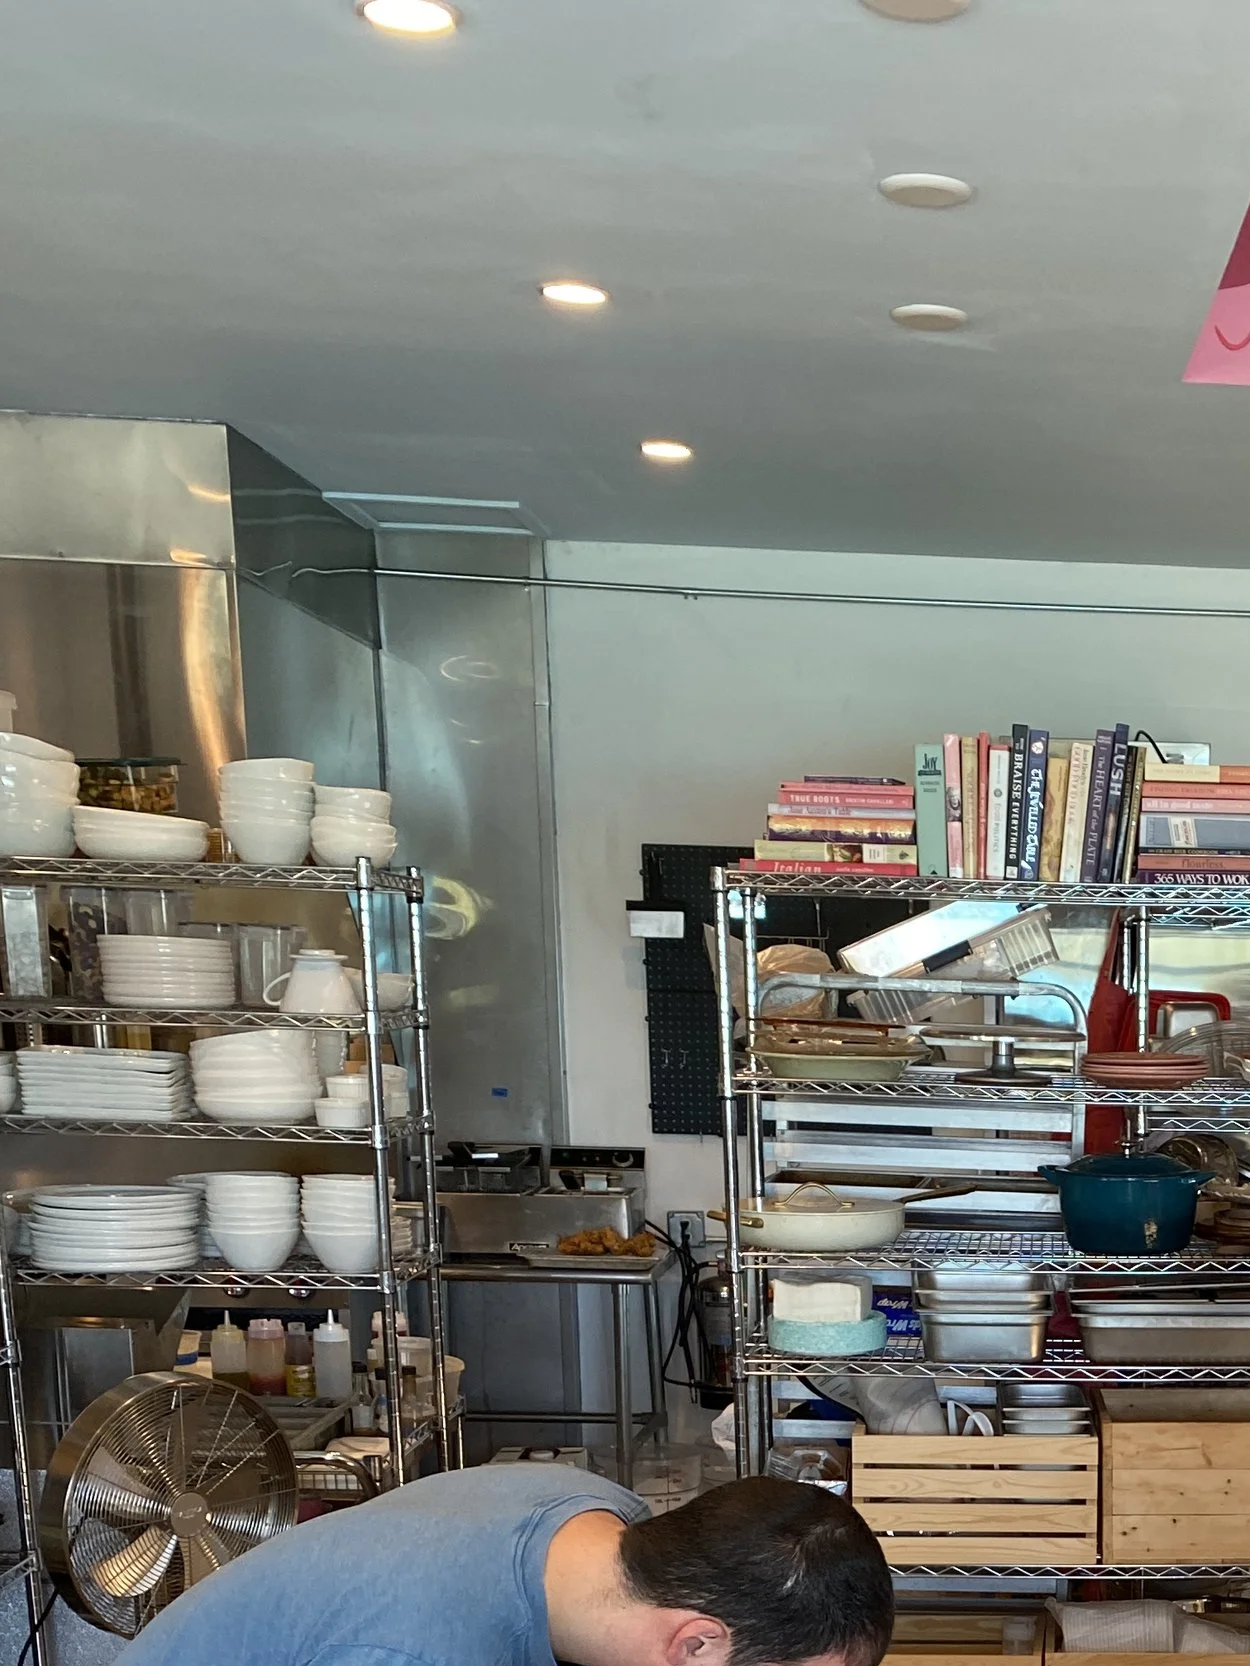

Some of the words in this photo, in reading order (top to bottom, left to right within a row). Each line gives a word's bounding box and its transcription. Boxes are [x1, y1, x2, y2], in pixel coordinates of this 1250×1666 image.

[1097, 756, 1106, 769] The
[1109, 743, 1128, 796] LUSH
[1011, 753, 1025, 799] BRAISE
[790, 795, 811, 803] TRUE
[813, 795, 841, 804] ROOTS
[1092, 769, 1105, 811] HEART
[1008, 801, 1021, 859] EVERYTHING
[1090, 819, 1098, 831] the
[1086, 832, 1098, 865] PLATE
[774, 862, 822, 873] Italian
[1154, 873, 1174, 884] 365
[1176, 873, 1205, 884] WAYS
[1206, 874, 1221, 884] TO
[1222, 874, 1250, 885] WOK
